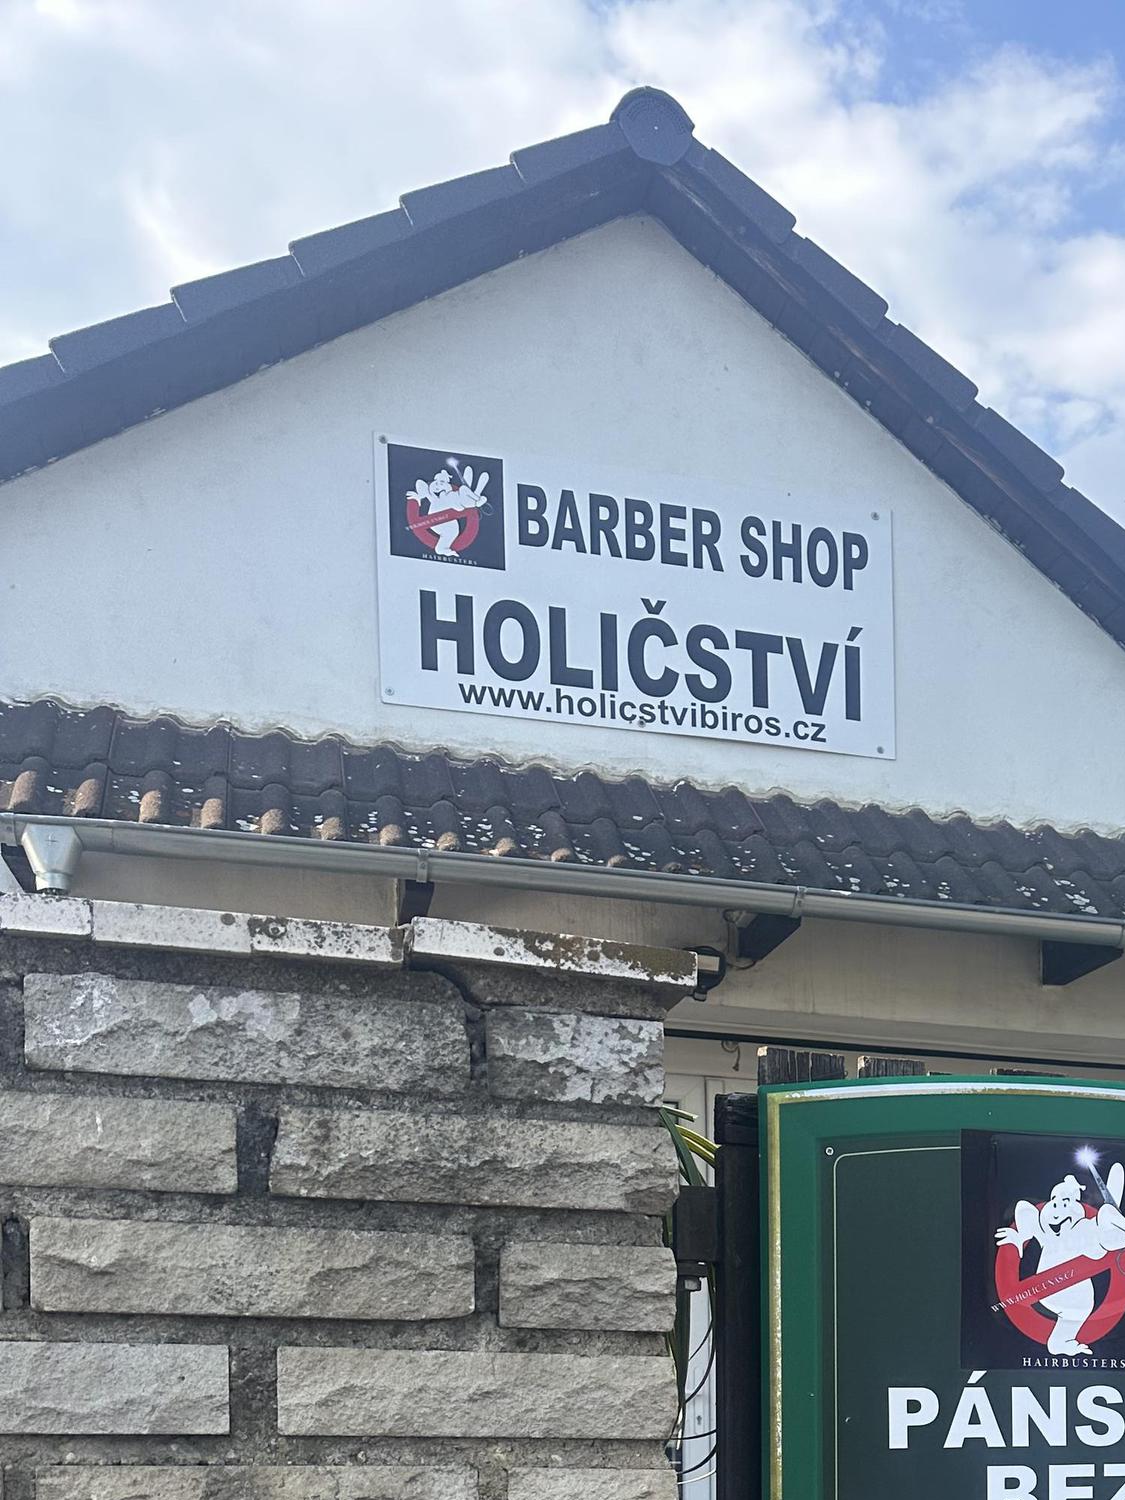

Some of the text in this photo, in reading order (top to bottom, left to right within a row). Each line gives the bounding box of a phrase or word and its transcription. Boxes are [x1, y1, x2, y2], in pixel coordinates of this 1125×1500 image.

[517, 483, 868, 591] BARBER SHOP
[419, 589, 864, 722] HOLIČSTVÍ
